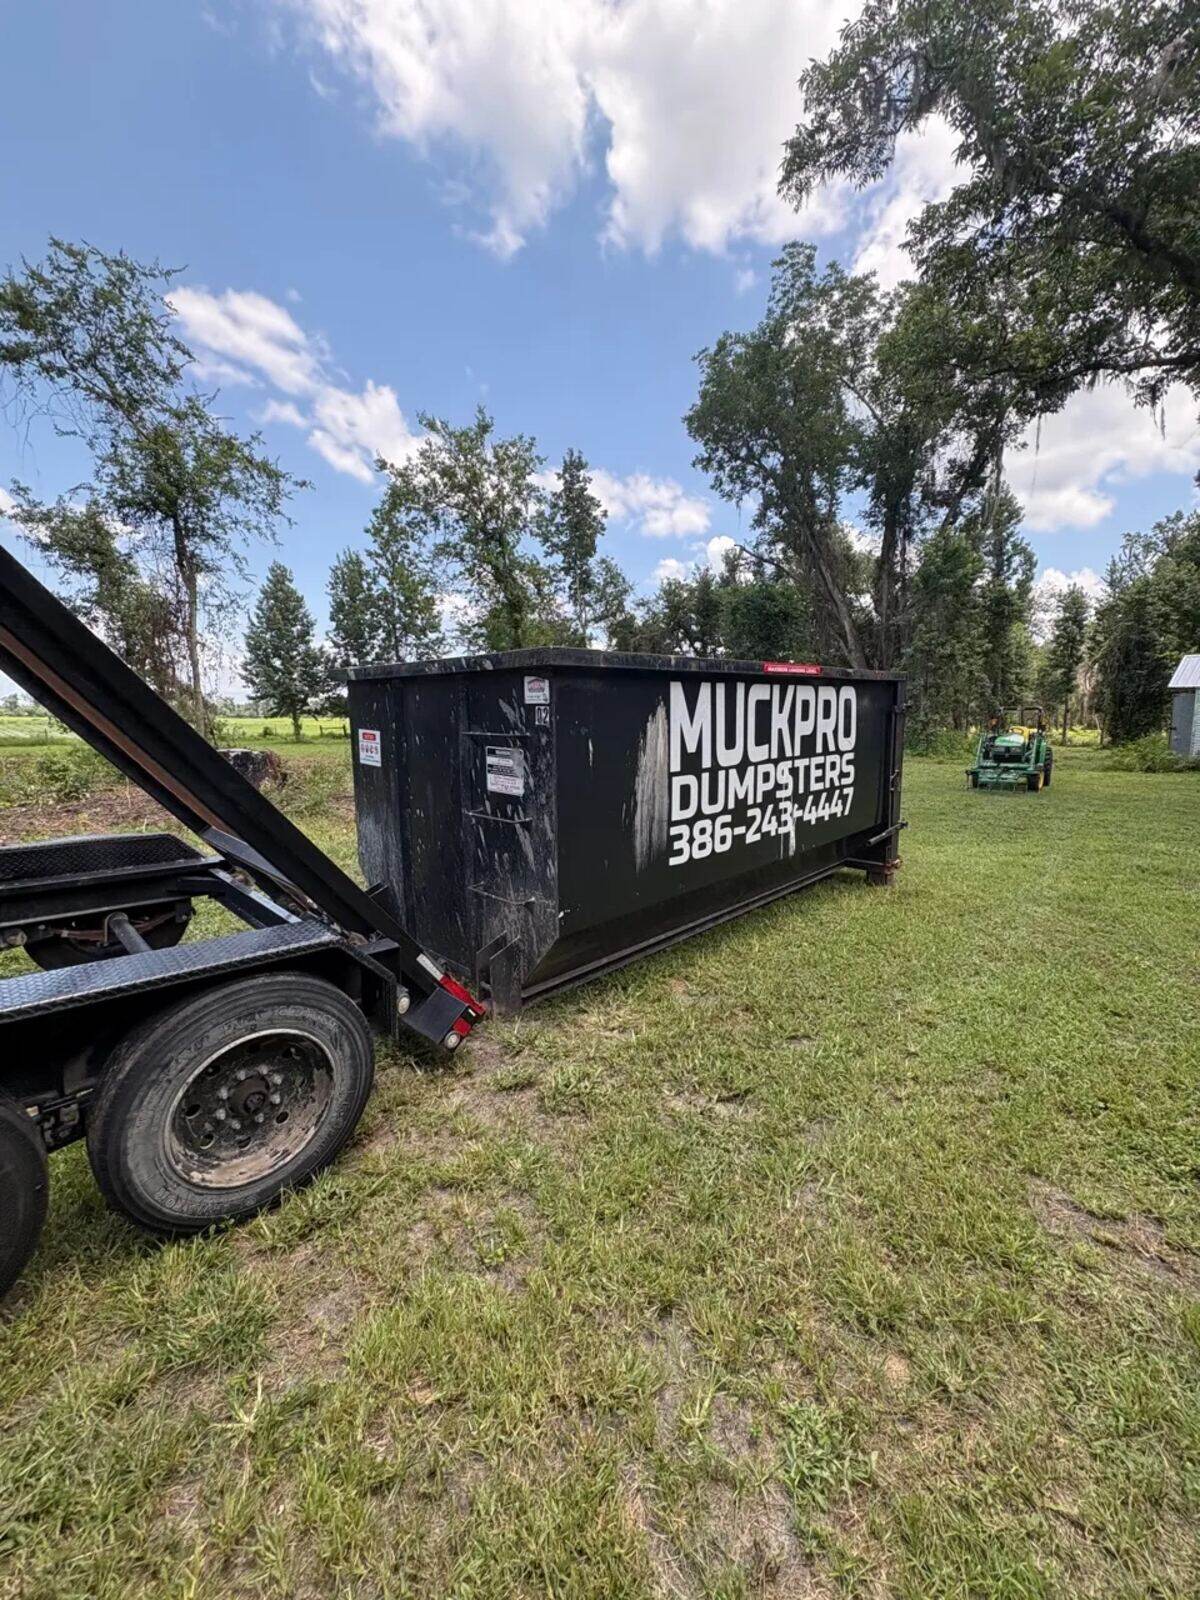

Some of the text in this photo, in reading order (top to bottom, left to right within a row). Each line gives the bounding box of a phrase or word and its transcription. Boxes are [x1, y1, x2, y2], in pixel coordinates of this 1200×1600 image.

[669, 681, 857, 773] MUCKPRO
[668, 787, 854, 866] 386-243-4447
[671, 752, 855, 822] DUMPSTERS
